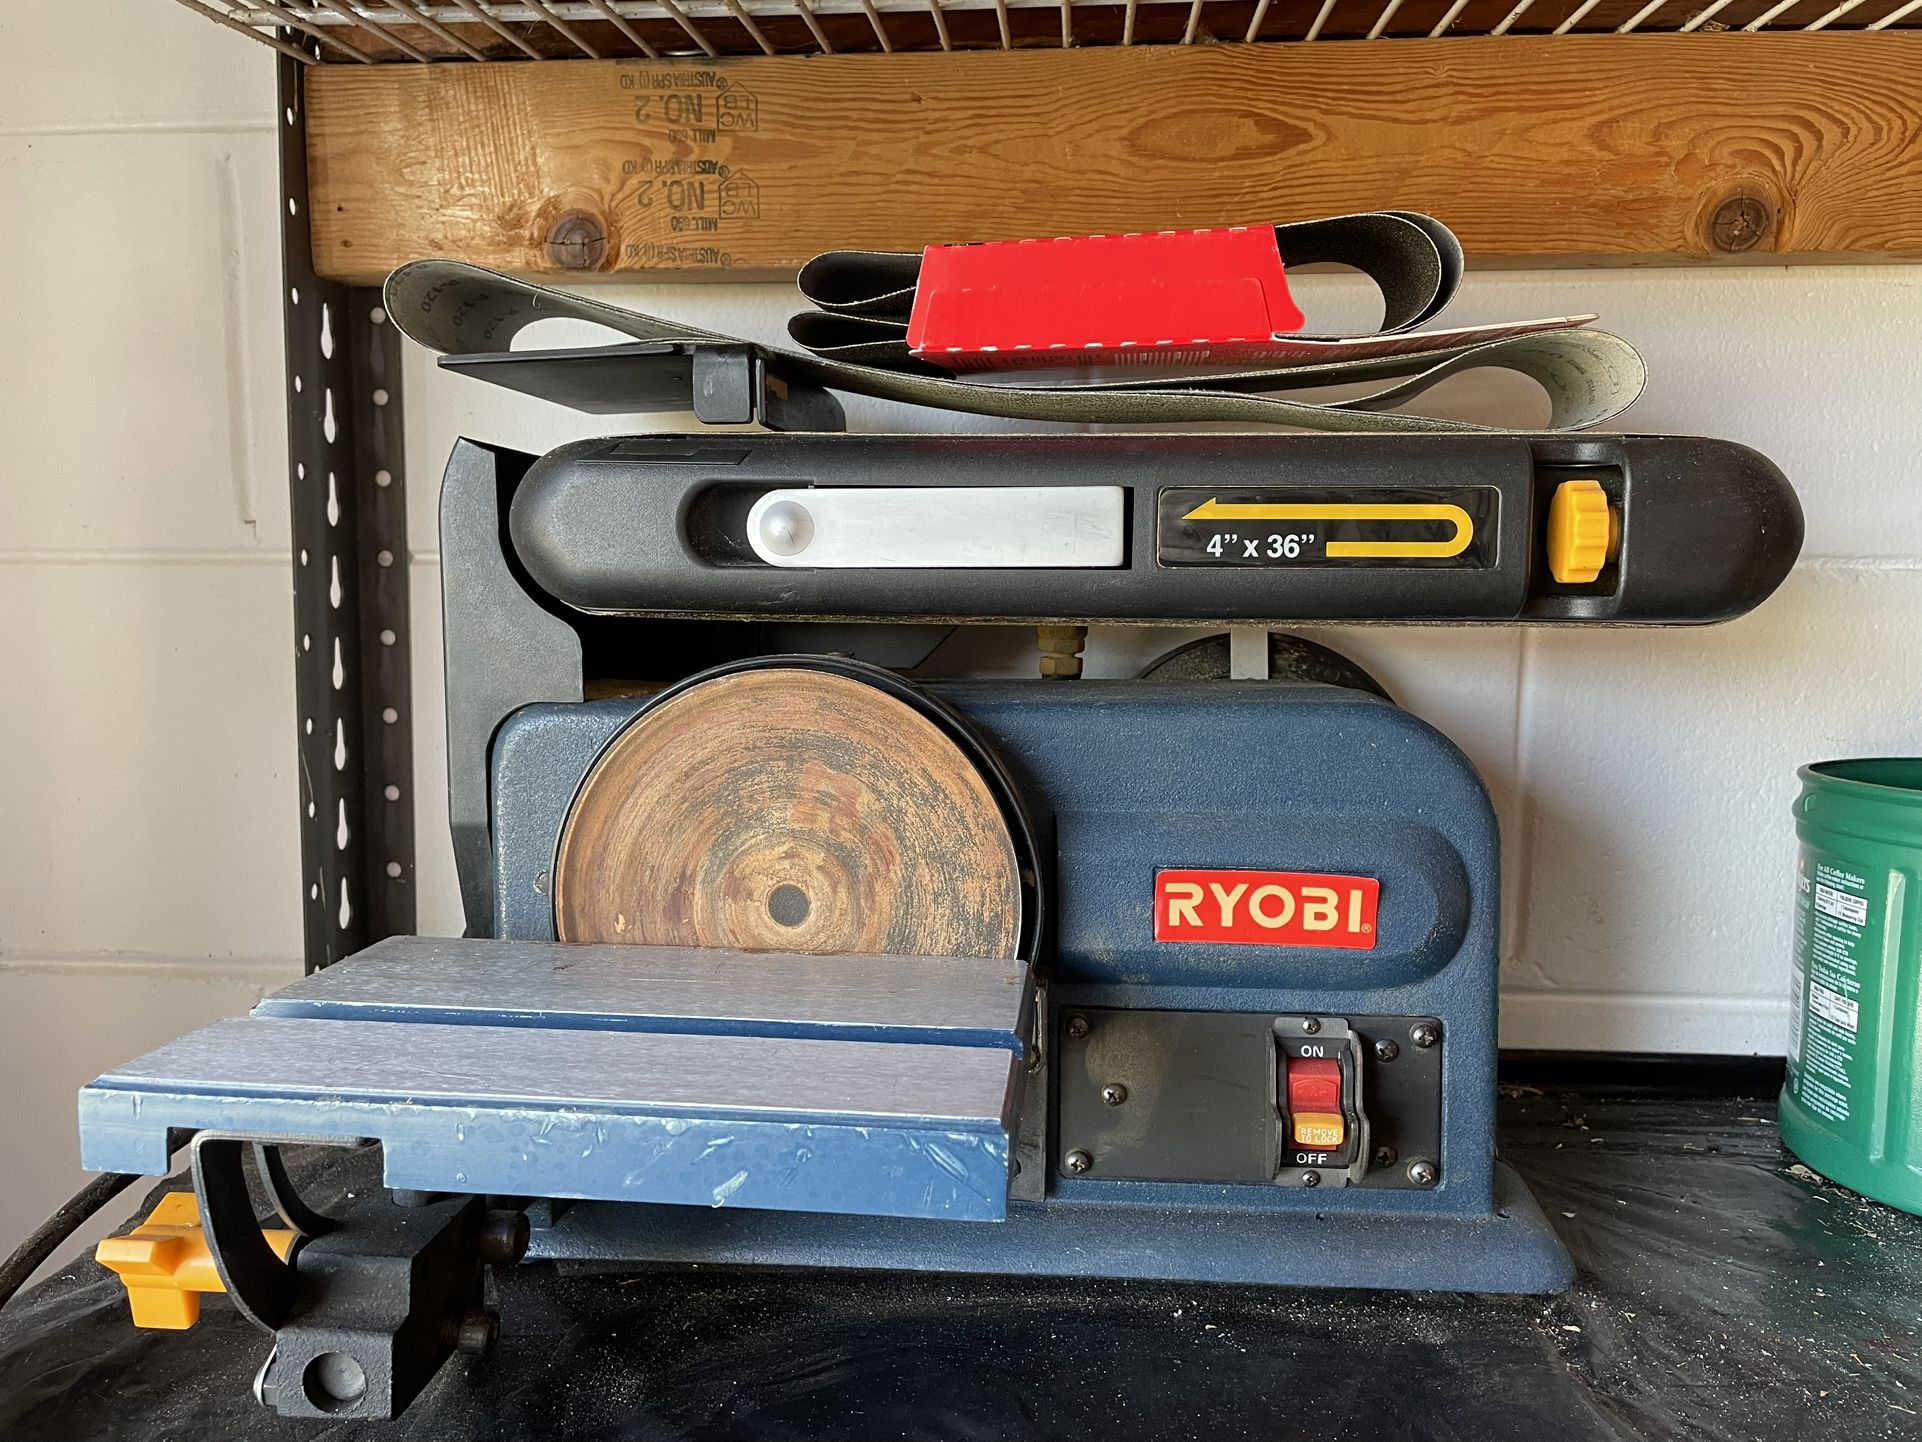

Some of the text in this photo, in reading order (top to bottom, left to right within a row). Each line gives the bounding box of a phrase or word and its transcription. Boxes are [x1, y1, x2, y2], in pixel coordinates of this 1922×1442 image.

[1206, 534, 1315, 558] 4” x 36”
[1845, 872, 1865, 884] Makers
[1300, 1045, 1324, 1057] ON
[1301, 1128, 1339, 1136] REMOVE
[1301, 1135, 1339, 1143] TO LOCK
[1296, 1152, 1327, 1165] OFF
